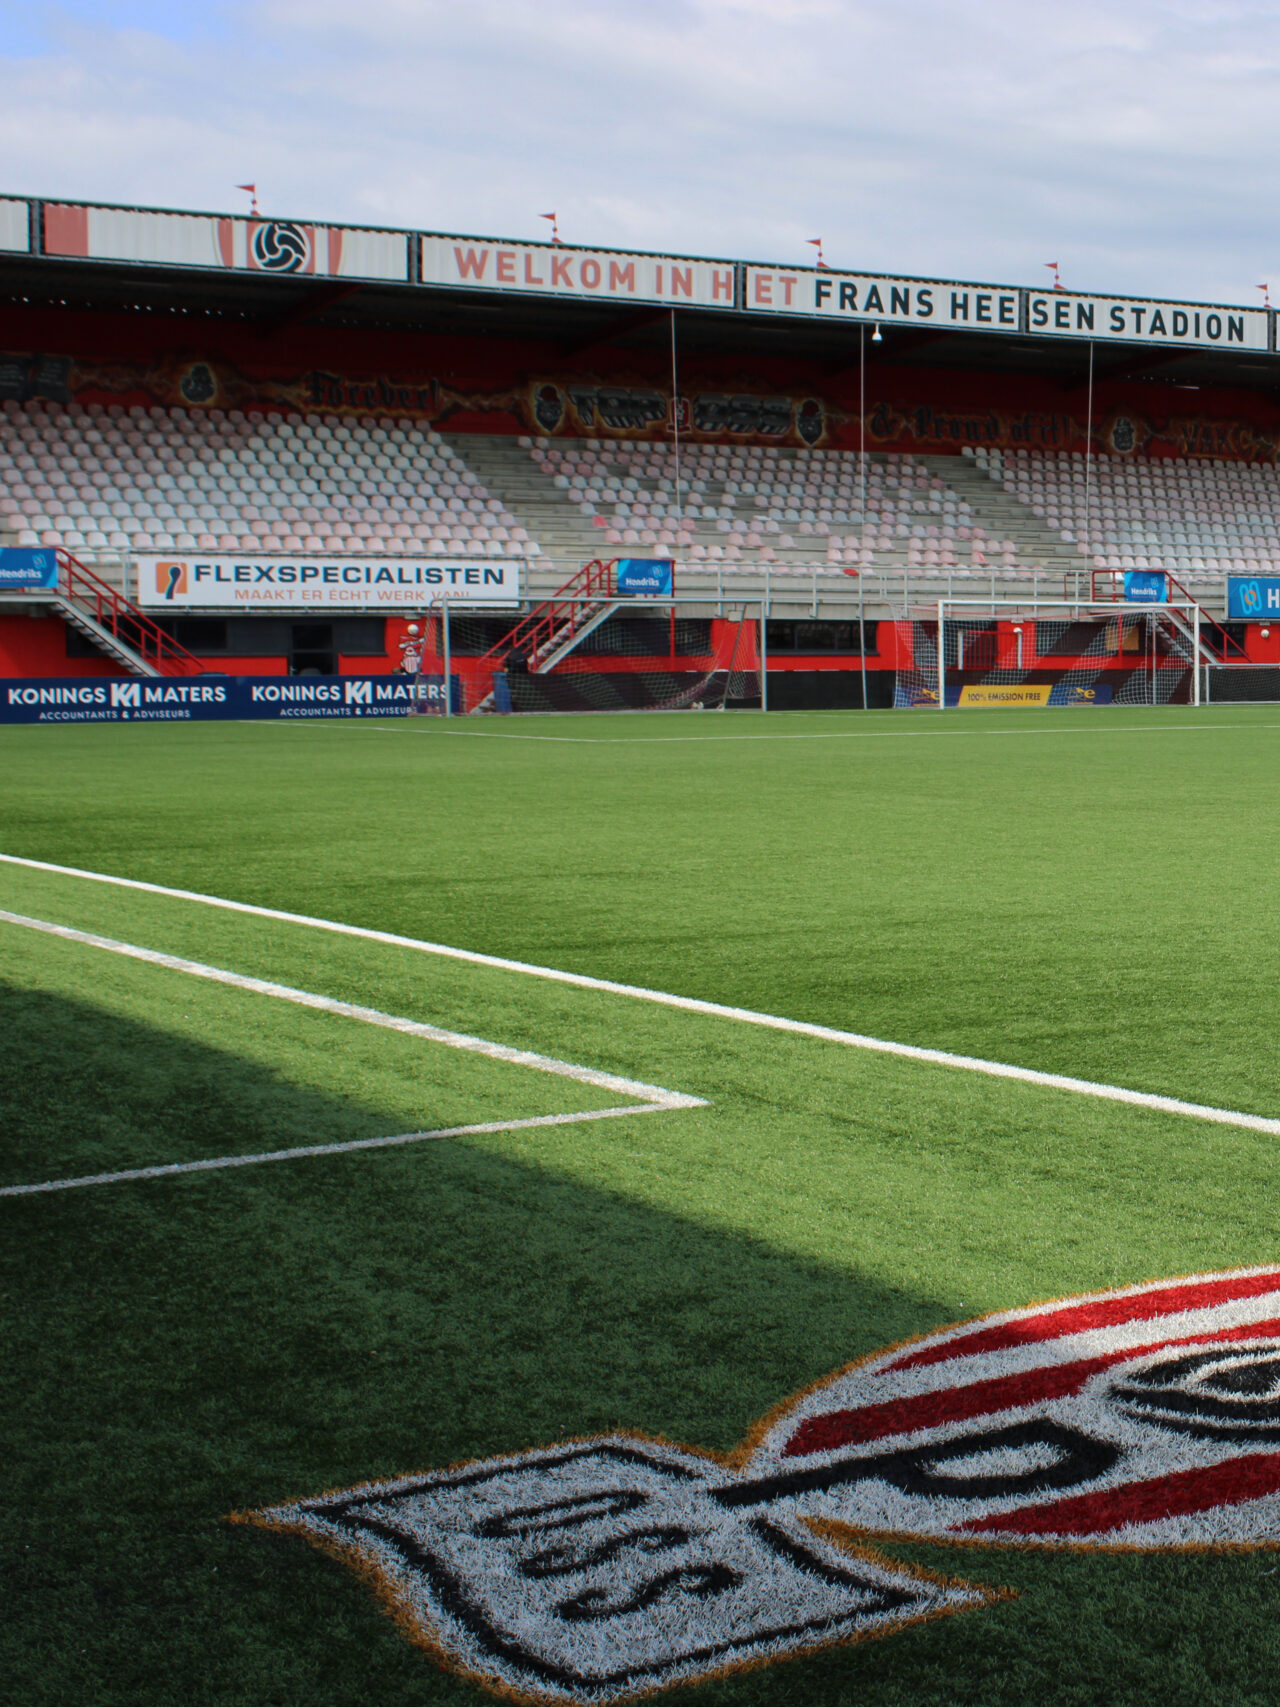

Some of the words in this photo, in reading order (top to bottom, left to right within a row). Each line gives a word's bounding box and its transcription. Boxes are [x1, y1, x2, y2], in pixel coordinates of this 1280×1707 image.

[454, 246, 635, 292] WELKOM
[656, 264, 692, 297] IN
[814, 278, 934, 318] FRANS
[1109, 305, 1244, 342] STADION
[193, 565, 504, 585] FLEXSPECIALISTEN
[625, 577, 660, 587] Hendriks
[234, 589, 297, 601] MAAKT
[301, 590, 323, 601] ER
[377, 590, 426, 601] WERK
[1131, 587, 1158, 596] Hendriks
[8, 687, 107, 705] KONINGS
[145, 686, 227, 703] MATERS
[251, 685, 341, 702] KONINGS
[376, 684, 448, 700] MATERS
[988, 692, 1024, 701] EMISSION
[1026, 692, 1041, 701] FREE
[39, 710, 118, 720] ACCOUNTANTS
[121, 710, 129, 719] &
[133, 709, 191, 719] ADVISEURS
[280, 707, 351, 717] ACCOUNTANTS
[355, 708, 362, 716] &
[473, 1487, 745, 1621] OSS
